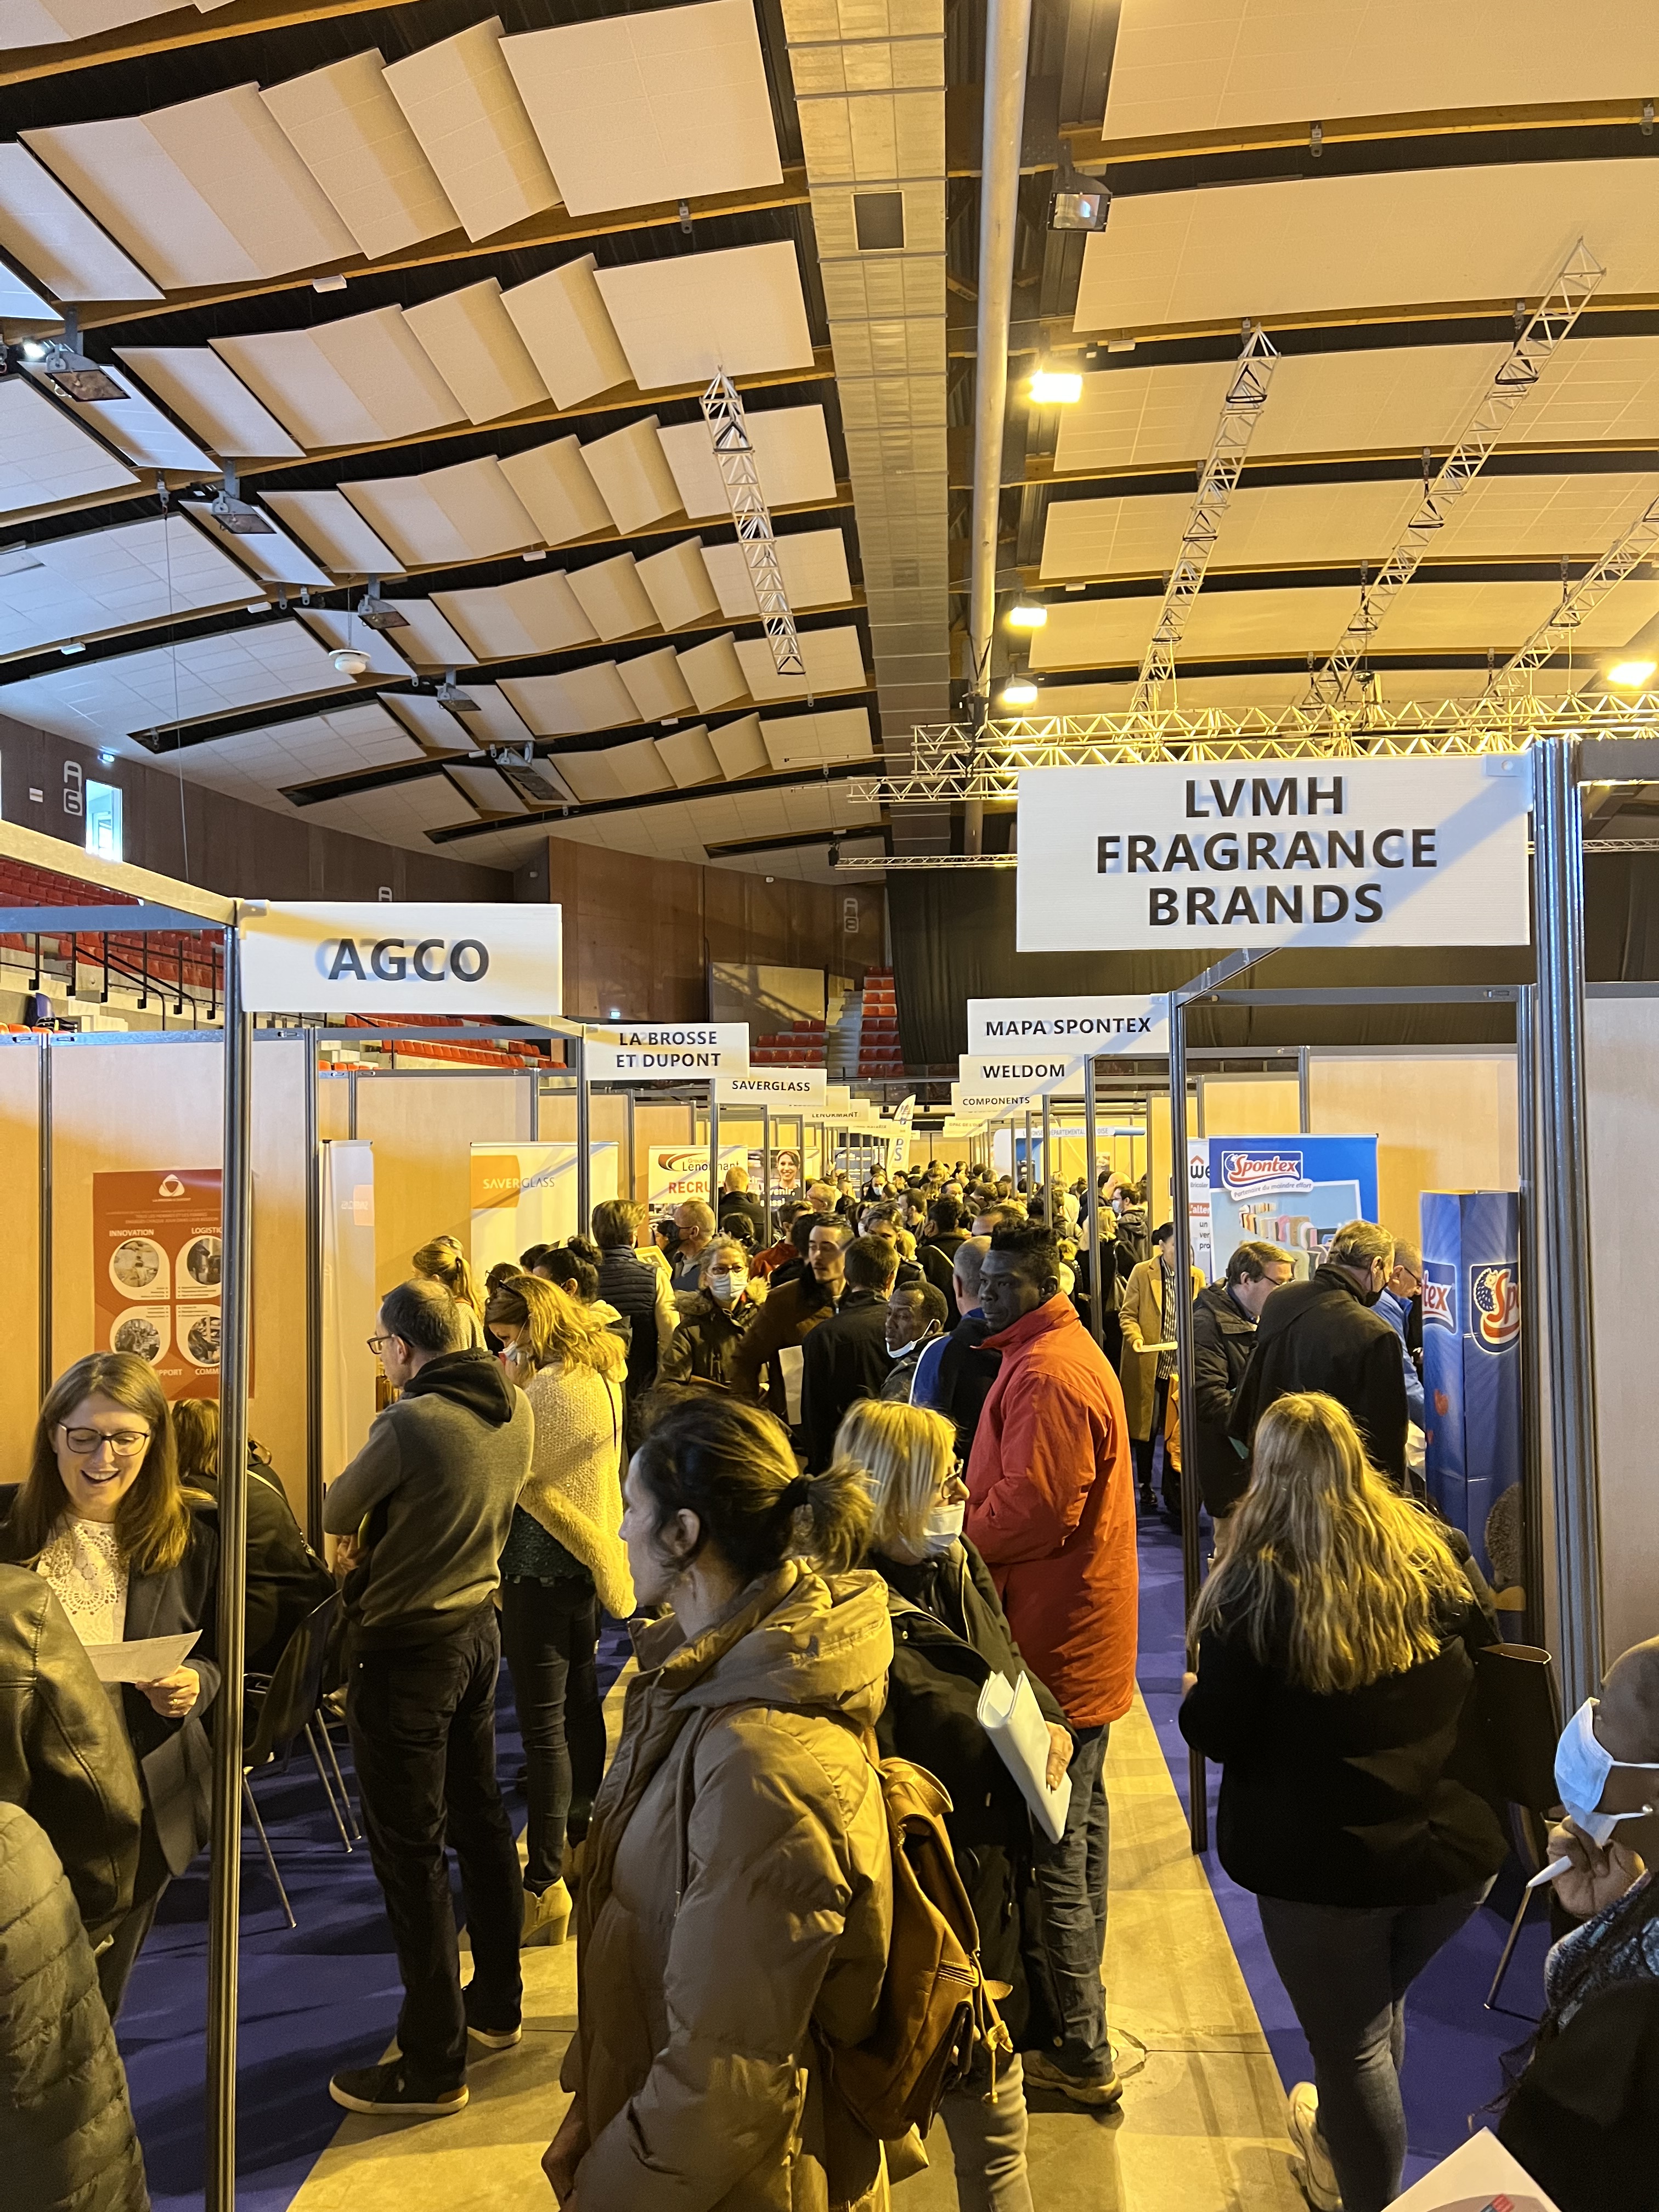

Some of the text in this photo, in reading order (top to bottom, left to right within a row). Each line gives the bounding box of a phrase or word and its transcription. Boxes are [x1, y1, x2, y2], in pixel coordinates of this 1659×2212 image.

[1185, 775, 1343, 818] LVMH
[1097, 828, 1437, 874] FRAGRANCE
[1148, 883, 1384, 927] BRANDS
[328, 938, 489, 982] AGCO
[986, 1017, 1152, 1036] MAPA SPONTEX
[619, 1030, 718, 1046] LA BROSSE
[616, 1052, 721, 1068] ET DUPONT
[983, 1064, 1065, 1079] WELDOM
[731, 1080, 811, 1092] SAVERGLASS
[962, 1096, 1030, 1105] COMPONENTS
[1231, 1154, 1296, 1177] Spontex
[482, 1176, 555, 1189] SAVERGLASS
[1234, 1186, 1261, 1198] Partenaire
[109, 1229, 155, 1237] INNOVATION
